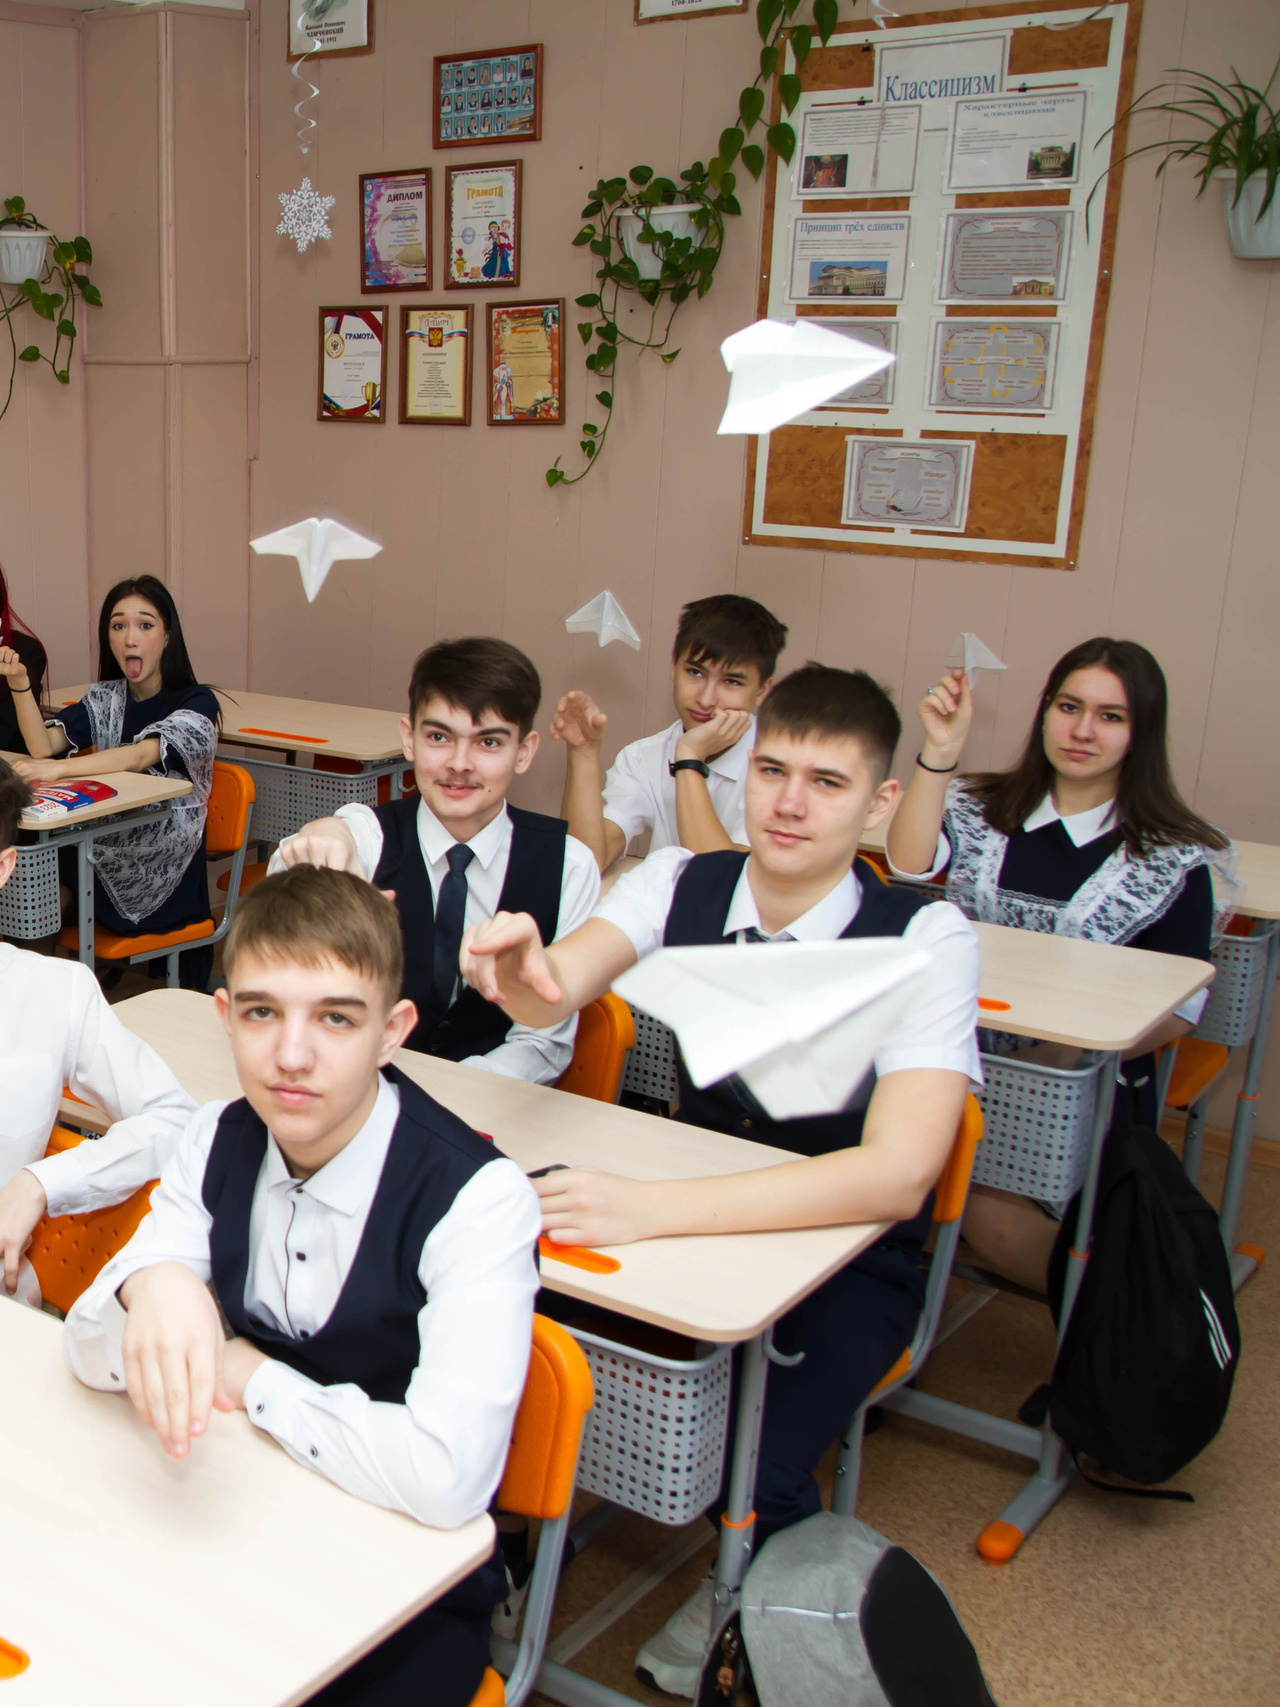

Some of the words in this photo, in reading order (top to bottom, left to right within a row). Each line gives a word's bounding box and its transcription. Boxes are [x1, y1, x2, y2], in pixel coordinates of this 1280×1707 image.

[885, 75, 996, 101] Классицизм
[963, 101, 1037, 111] Характерные
[983, 107, 1055, 117] классицизма
[387, 191, 423, 203] ДИПЛОМ
[467, 185, 504, 200] ГРАМОТА
[800, 222, 842, 235] Принцип
[845, 221, 864, 234] трёх
[867, 222, 905, 232] единств
